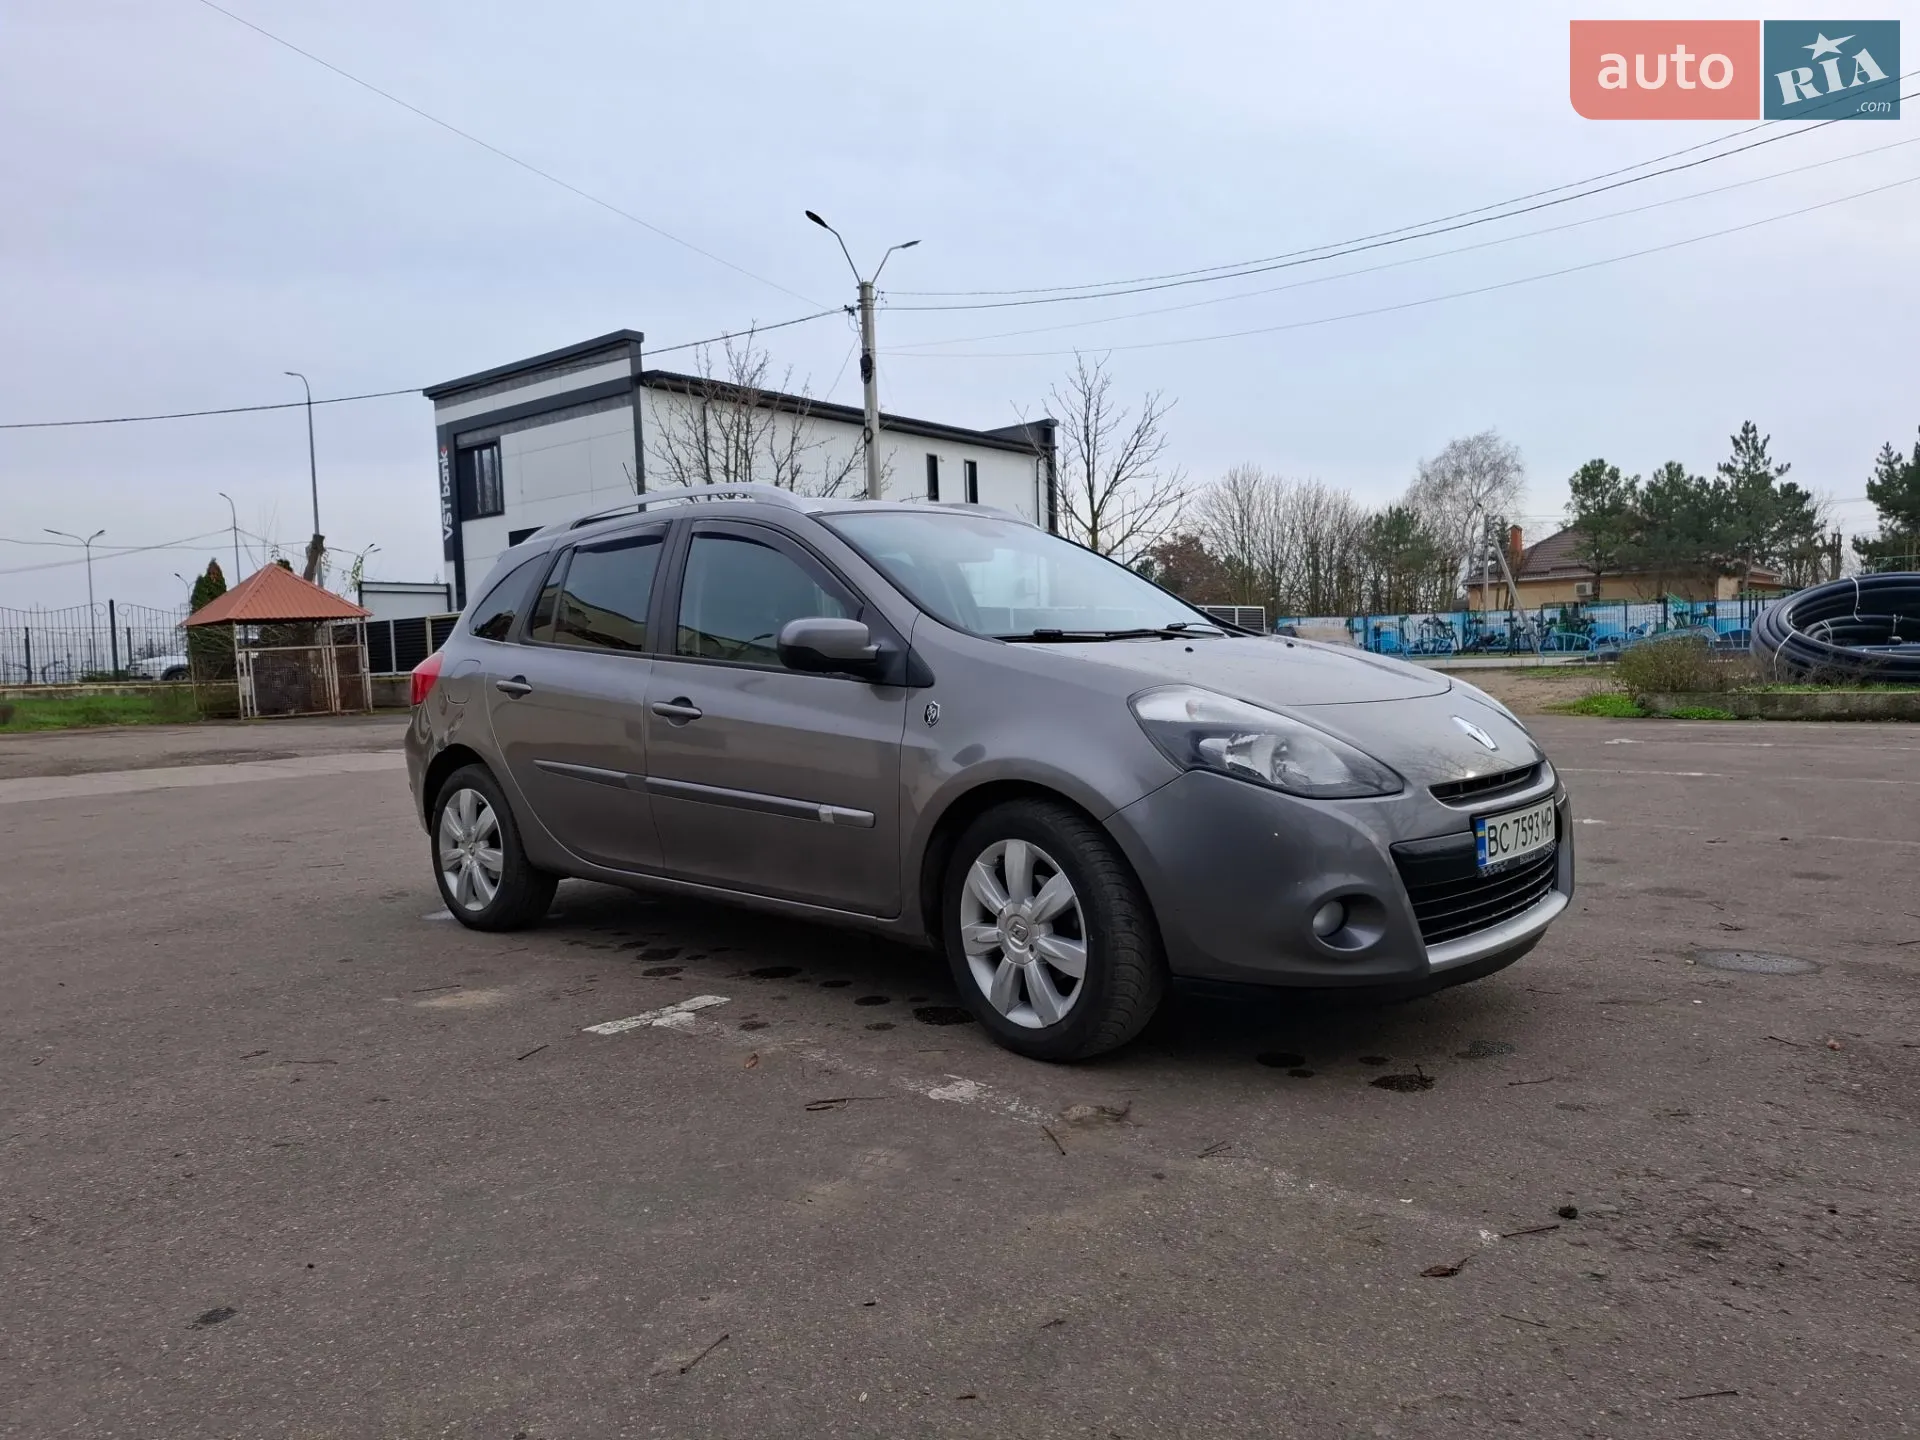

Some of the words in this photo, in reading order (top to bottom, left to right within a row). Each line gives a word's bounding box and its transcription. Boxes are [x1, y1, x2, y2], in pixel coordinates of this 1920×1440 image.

[439, 449, 450, 497] bank
[442, 500, 453, 540] VST
[1488, 822, 1509, 857] BC
[1513, 812, 1540, 850] 7593
